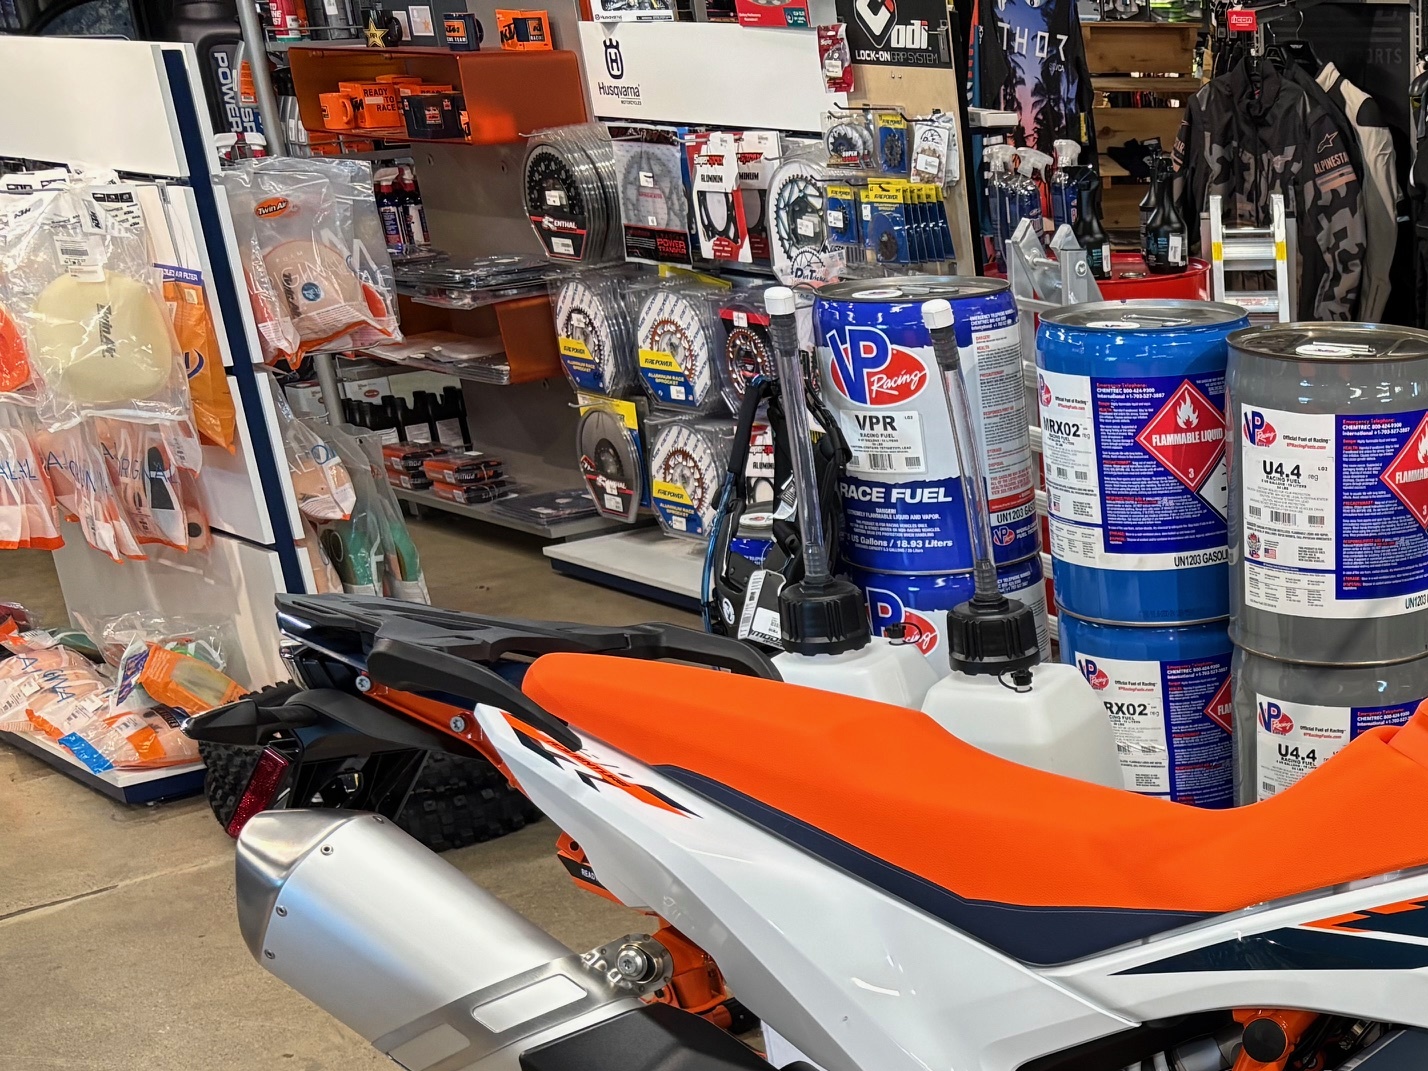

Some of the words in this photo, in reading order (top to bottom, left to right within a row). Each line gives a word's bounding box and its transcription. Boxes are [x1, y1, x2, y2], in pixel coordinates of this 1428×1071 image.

[890, 20, 929, 49] odi
[855, 50, 891, 62] LOCK-ON
[891, 51, 907, 62] GRIP
[908, 52, 939, 64] SYSTEM
[213, 52, 243, 134] POWER
[363, 88, 388, 97] READY
[598, 81, 641, 99] Husqvarna
[376, 103, 397, 112] RACE
[384, 96, 395, 104] TO
[257, 202, 276, 215] Twin
[826, 326, 892, 405] VP
[870, 367, 927, 398] Racing
[855, 414, 898, 432] VPR
[1244, 410, 1265, 445] VP
[1151, 432, 1200, 447] FLAMMABLE
[1201, 427, 1223, 443] LIQUID
[1188, 468, 1195, 478] 3
[1262, 459, 1302, 480] U4.4
[1287, 477, 1301, 485] FUEL
[839, 482, 885, 503] RACE
[890, 487, 953, 504] FUEL
[996, 507, 1024, 524] UN1203
[1422, 504, 1427, 516] 3
[860, 536, 888, 547] Gallons
[896, 539, 923, 548] 18.93
[925, 539, 953, 548] Liters
[1173, 554, 1202, 567] UN1203
[1404, 596, 1427, 610] UN1203
[866, 586, 905, 638] P
[1103, 701, 1149, 717] RX02
[1259, 701, 1282, 733] VP
[1277, 743, 1317, 762] U4.4
